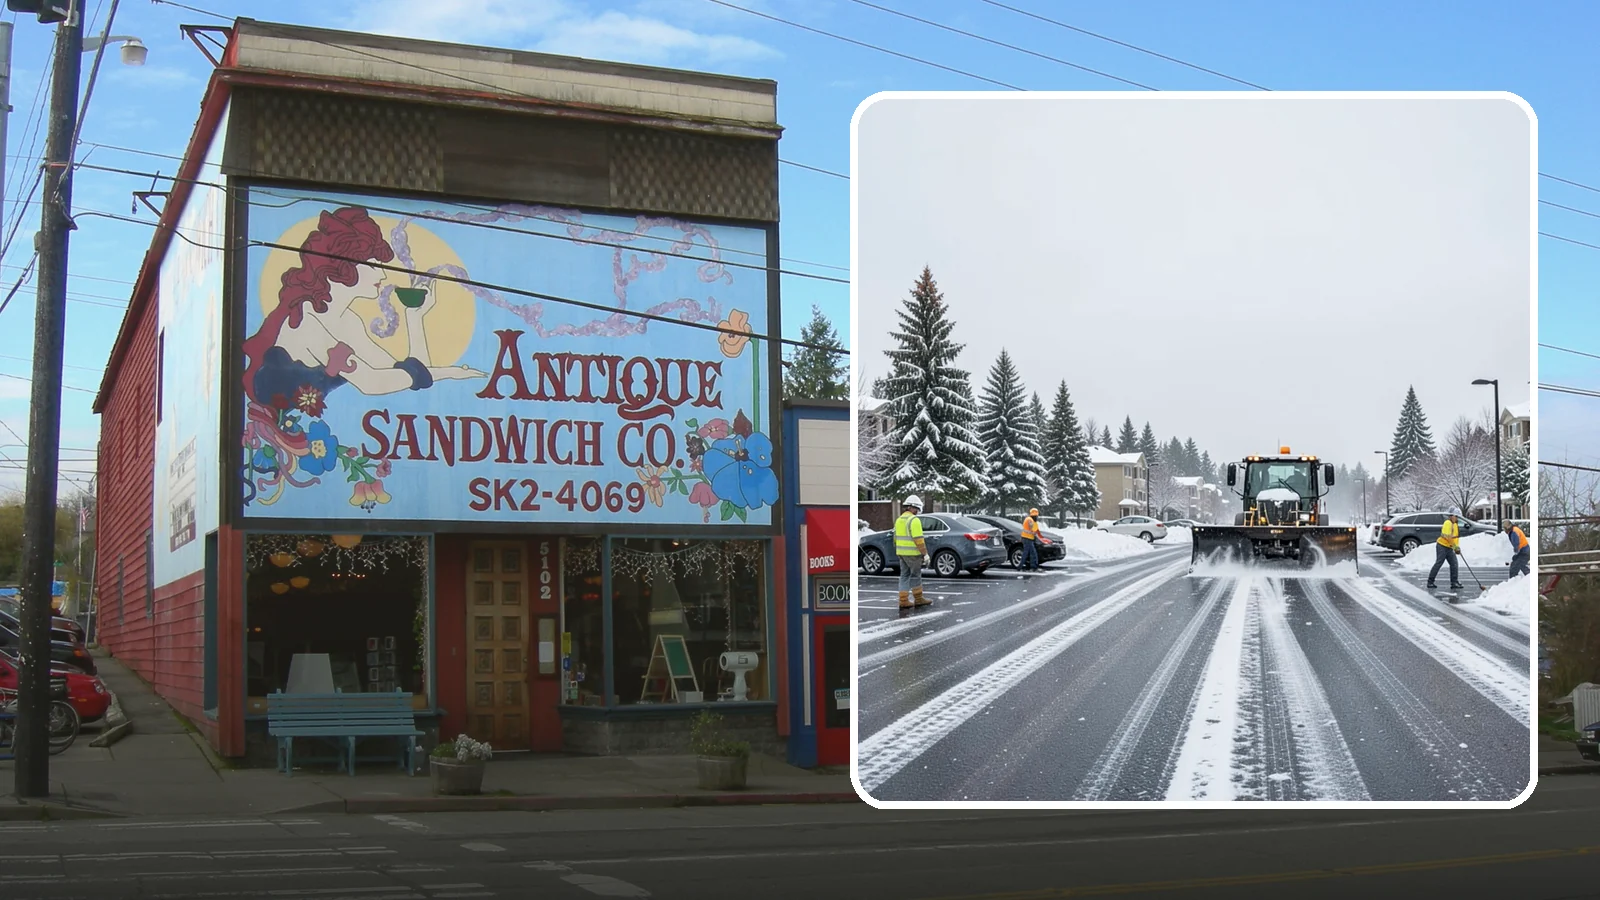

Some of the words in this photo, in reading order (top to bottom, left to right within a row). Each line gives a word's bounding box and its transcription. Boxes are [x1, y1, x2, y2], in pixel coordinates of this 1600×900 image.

[476, 329, 723, 420] ANTIQUE
[361, 408, 604, 467] SANDWICH
[617, 421, 685, 469] CO.
[468, 477, 646, 514] SK2-4069
[540, 542, 551, 599] 5102
[809, 555, 835, 569] BOOKS
